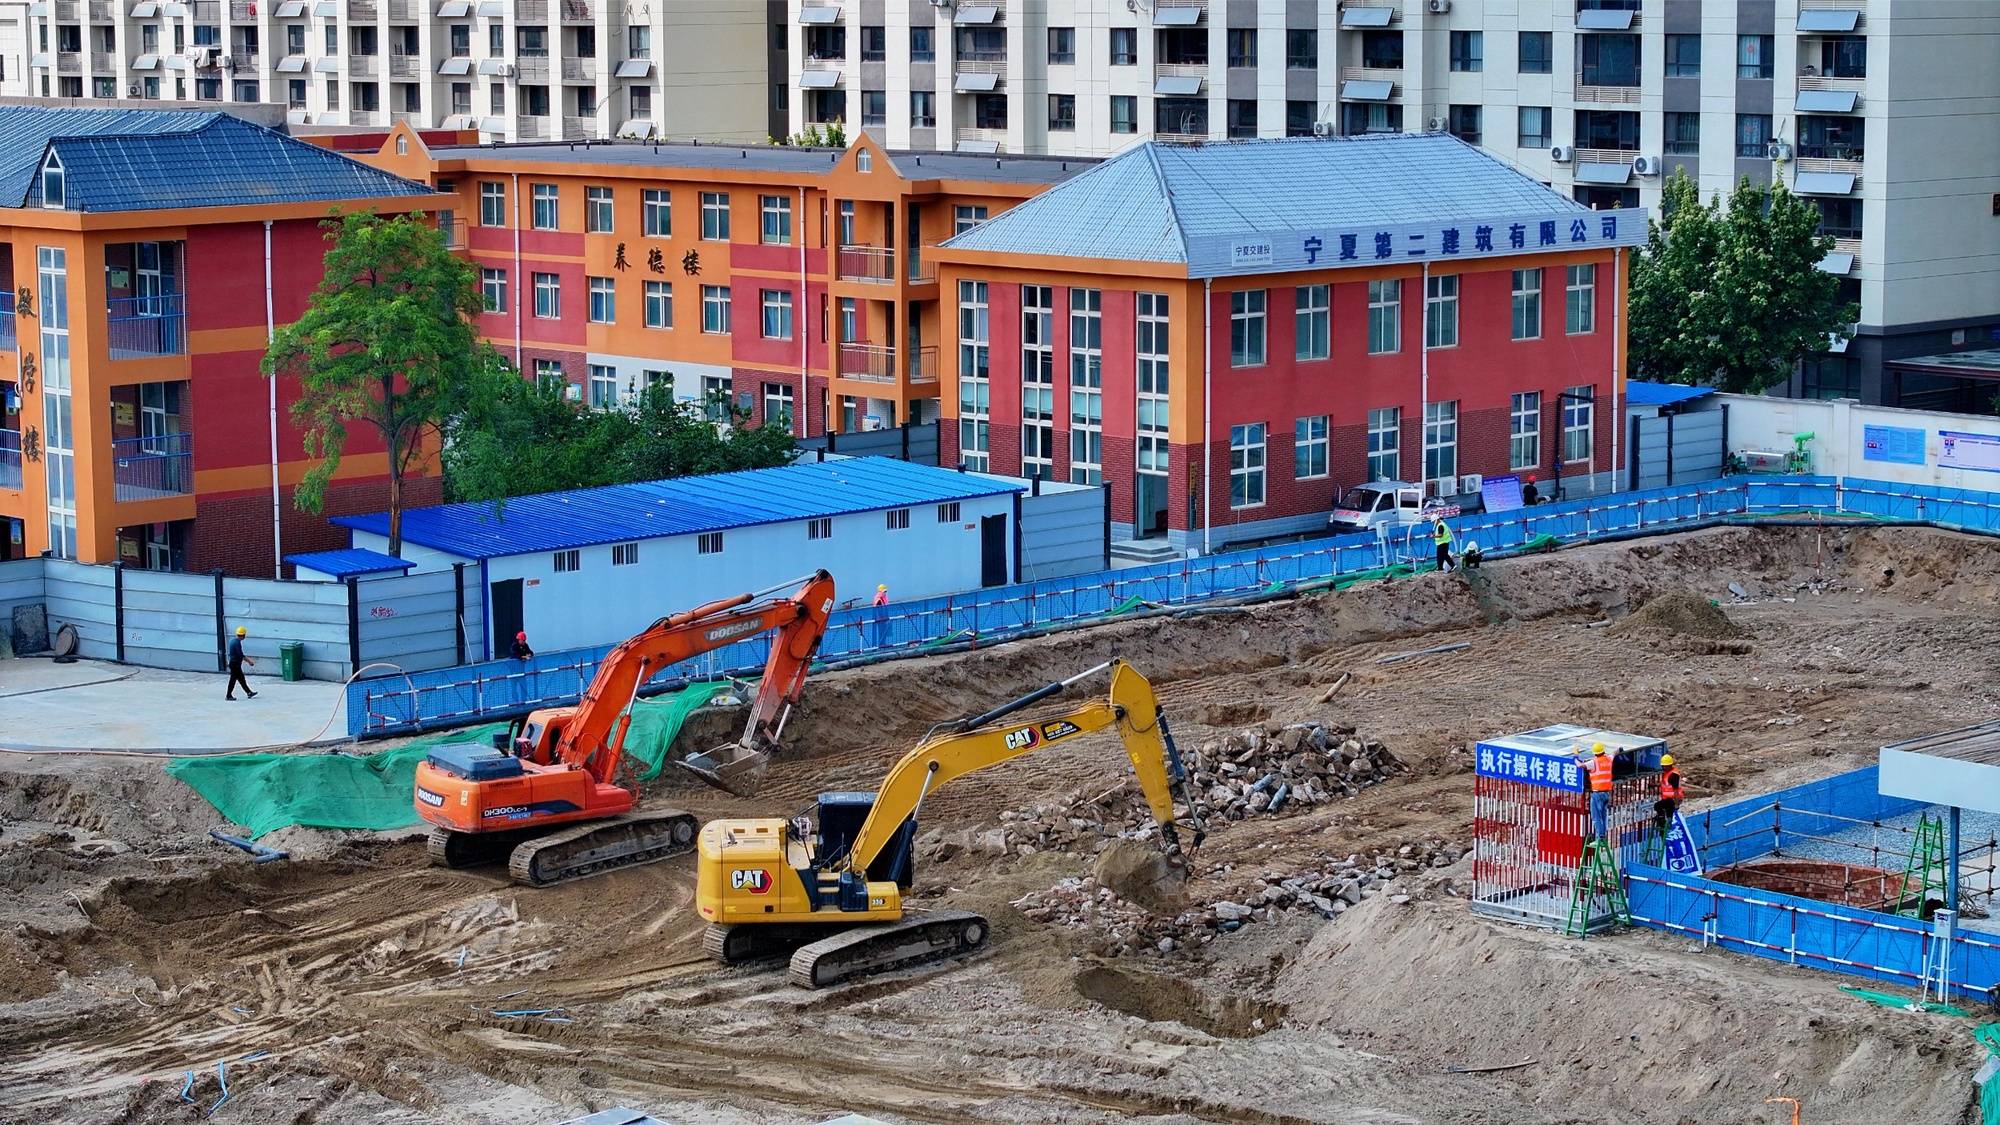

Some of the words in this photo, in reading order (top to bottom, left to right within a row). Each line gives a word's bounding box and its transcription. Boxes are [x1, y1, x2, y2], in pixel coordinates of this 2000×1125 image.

[1303, 215, 1618, 264] 宁夏第二建筑有限公司
[613, 241, 703, 277] 养德楼
[708, 618, 760, 641] DOOSAN
[1005, 727, 1032, 750] CAT
[1480, 748, 1579, 788] 执行操作规程
[417, 787, 443, 806] DOOSAN
[731, 869, 764, 889] CAT
